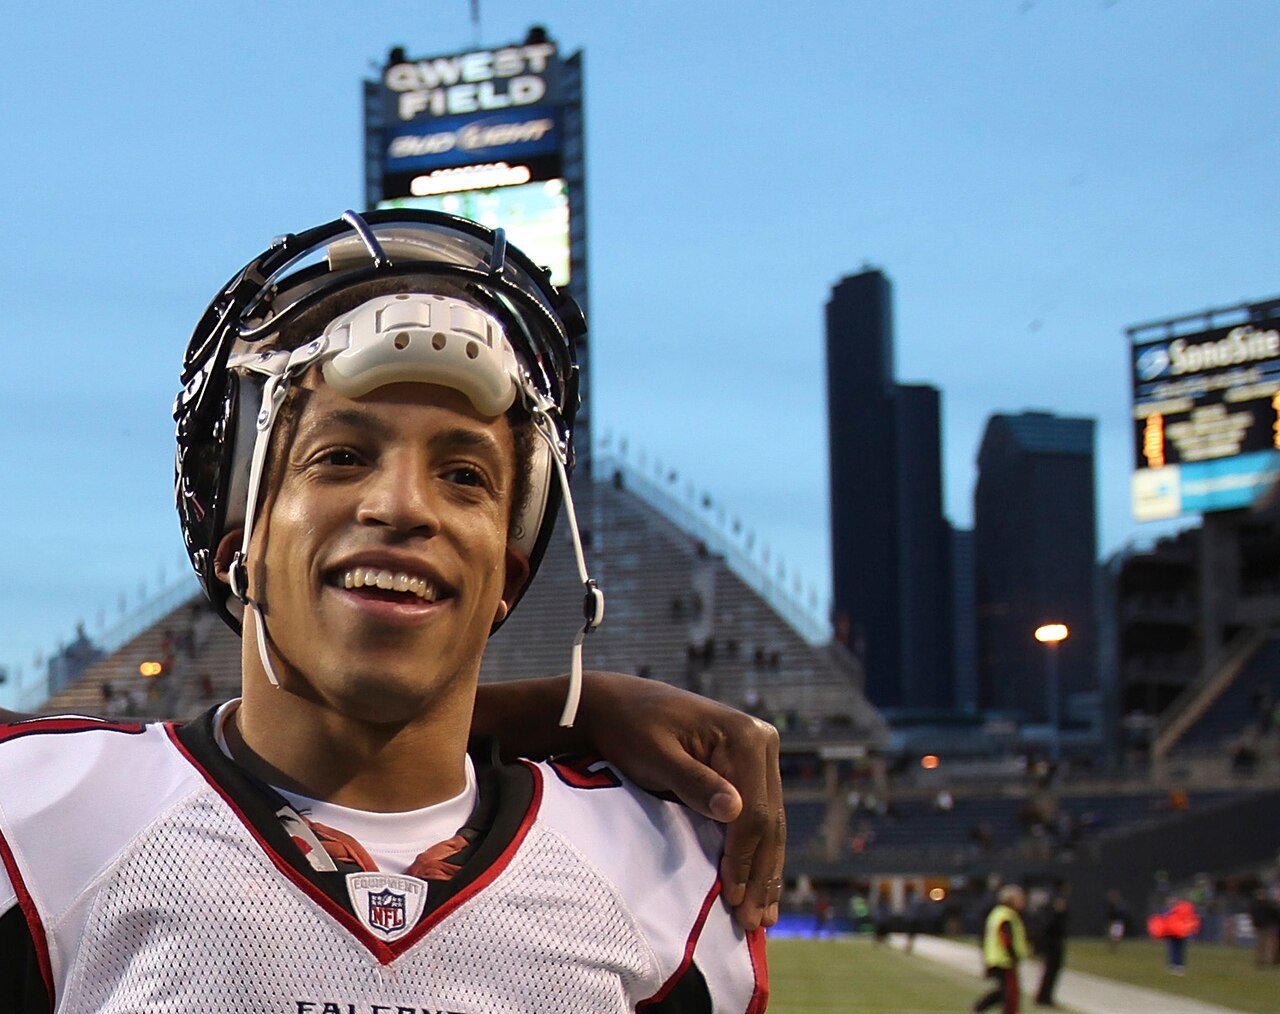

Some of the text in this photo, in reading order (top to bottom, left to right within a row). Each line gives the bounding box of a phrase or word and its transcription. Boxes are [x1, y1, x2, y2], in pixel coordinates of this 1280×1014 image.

[385, 44, 554, 91] QWEST
[398, 75, 546, 121] FIELD
[373, 907, 403, 928] NFL
